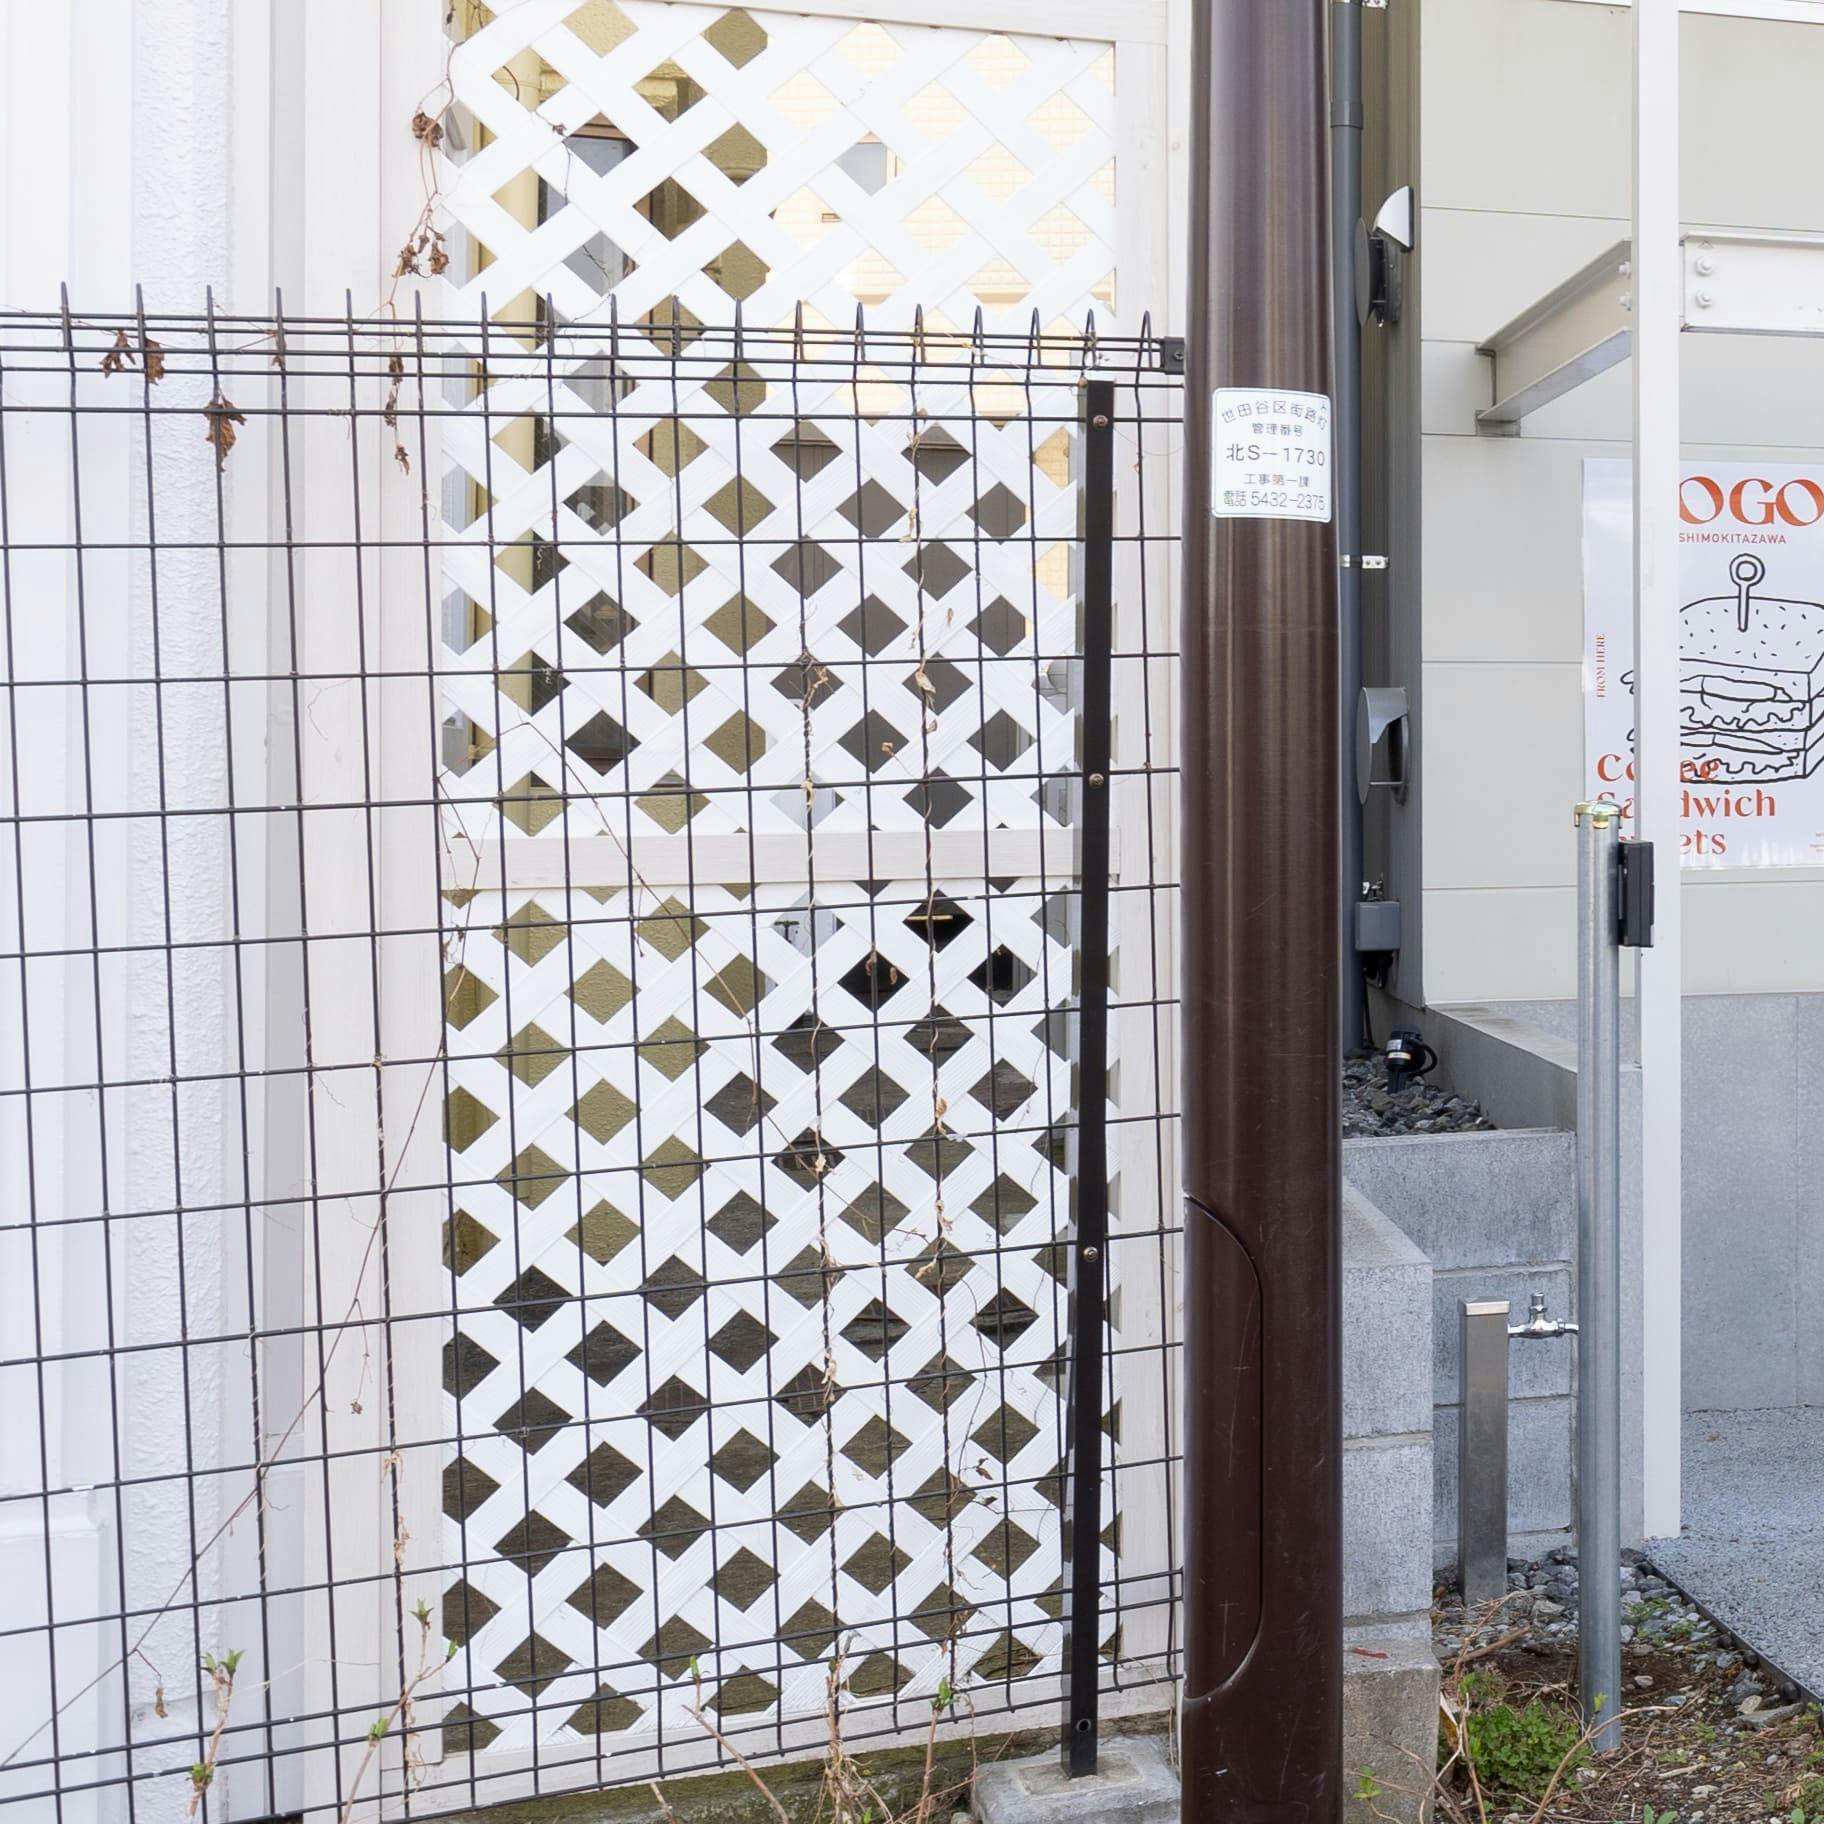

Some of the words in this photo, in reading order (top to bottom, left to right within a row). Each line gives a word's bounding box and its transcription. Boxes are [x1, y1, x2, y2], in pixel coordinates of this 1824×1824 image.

[1222, 401, 1327, 430] 世田谷区街路灯
[1252, 423, 1303, 437] 管理番号
[1679, 532, 1787, 545] SHIMOKITAZAWA
[1596, 633, 1606, 663] HERE
[1596, 666, 1606, 698] FROM
